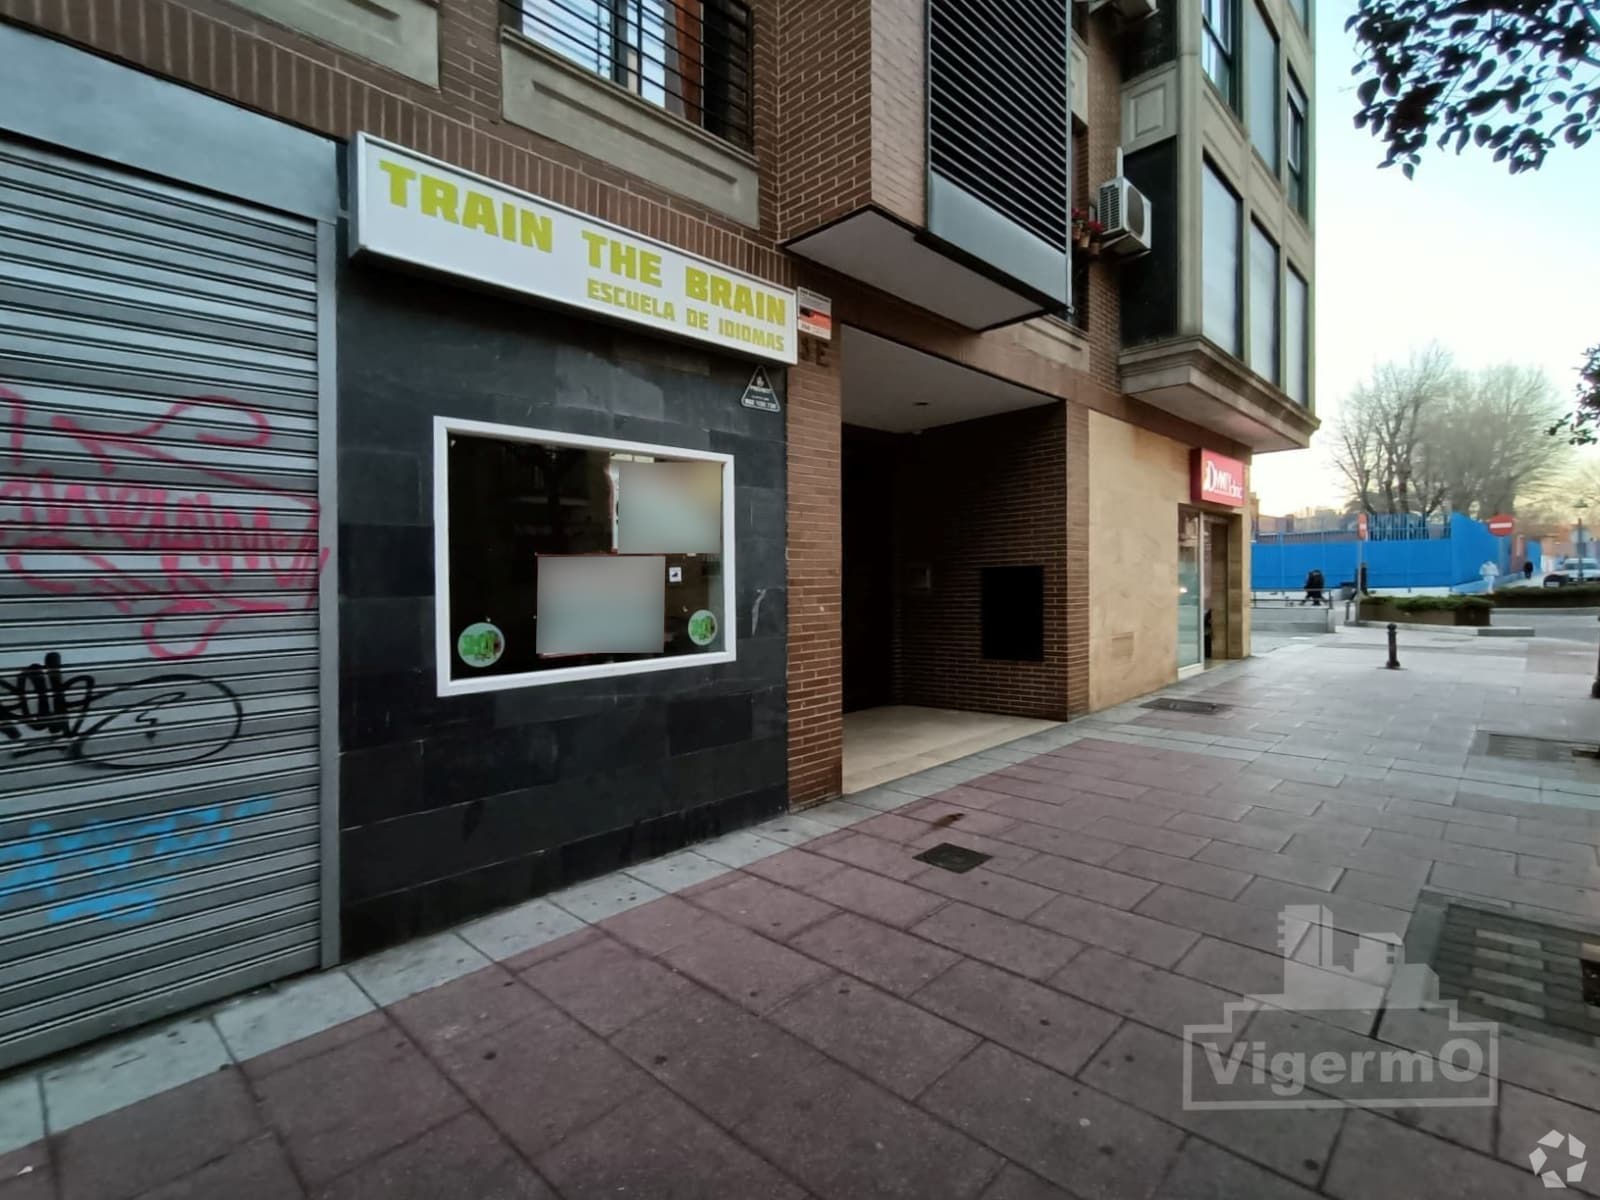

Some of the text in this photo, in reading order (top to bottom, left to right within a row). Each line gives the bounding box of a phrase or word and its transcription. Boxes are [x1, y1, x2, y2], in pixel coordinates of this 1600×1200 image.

[379, 162, 785, 325] TRAIN THE BRAIN
[588, 280, 675, 321] ESCUELA
[687, 309, 708, 330] DE
[719, 319, 785, 352] IDIOMAS
